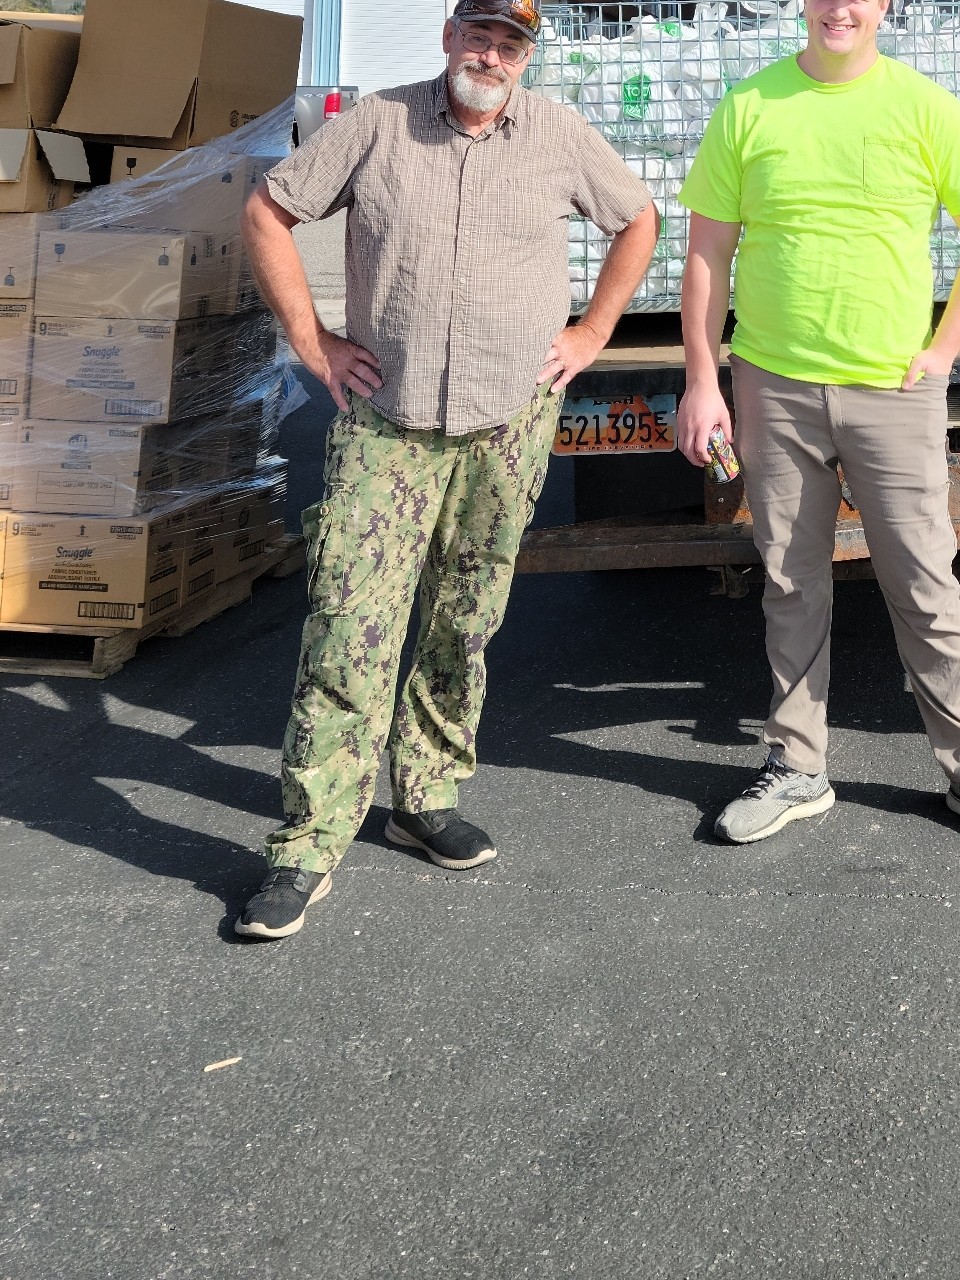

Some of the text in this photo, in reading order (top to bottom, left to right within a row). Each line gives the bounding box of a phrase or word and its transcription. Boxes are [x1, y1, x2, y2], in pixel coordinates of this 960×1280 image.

[82, 346, 121, 360] Snuggle
[558, 411, 652, 446] 521395
[12, 522, 20, 536] 9
[56, 546, 94, 560] Snuggle
